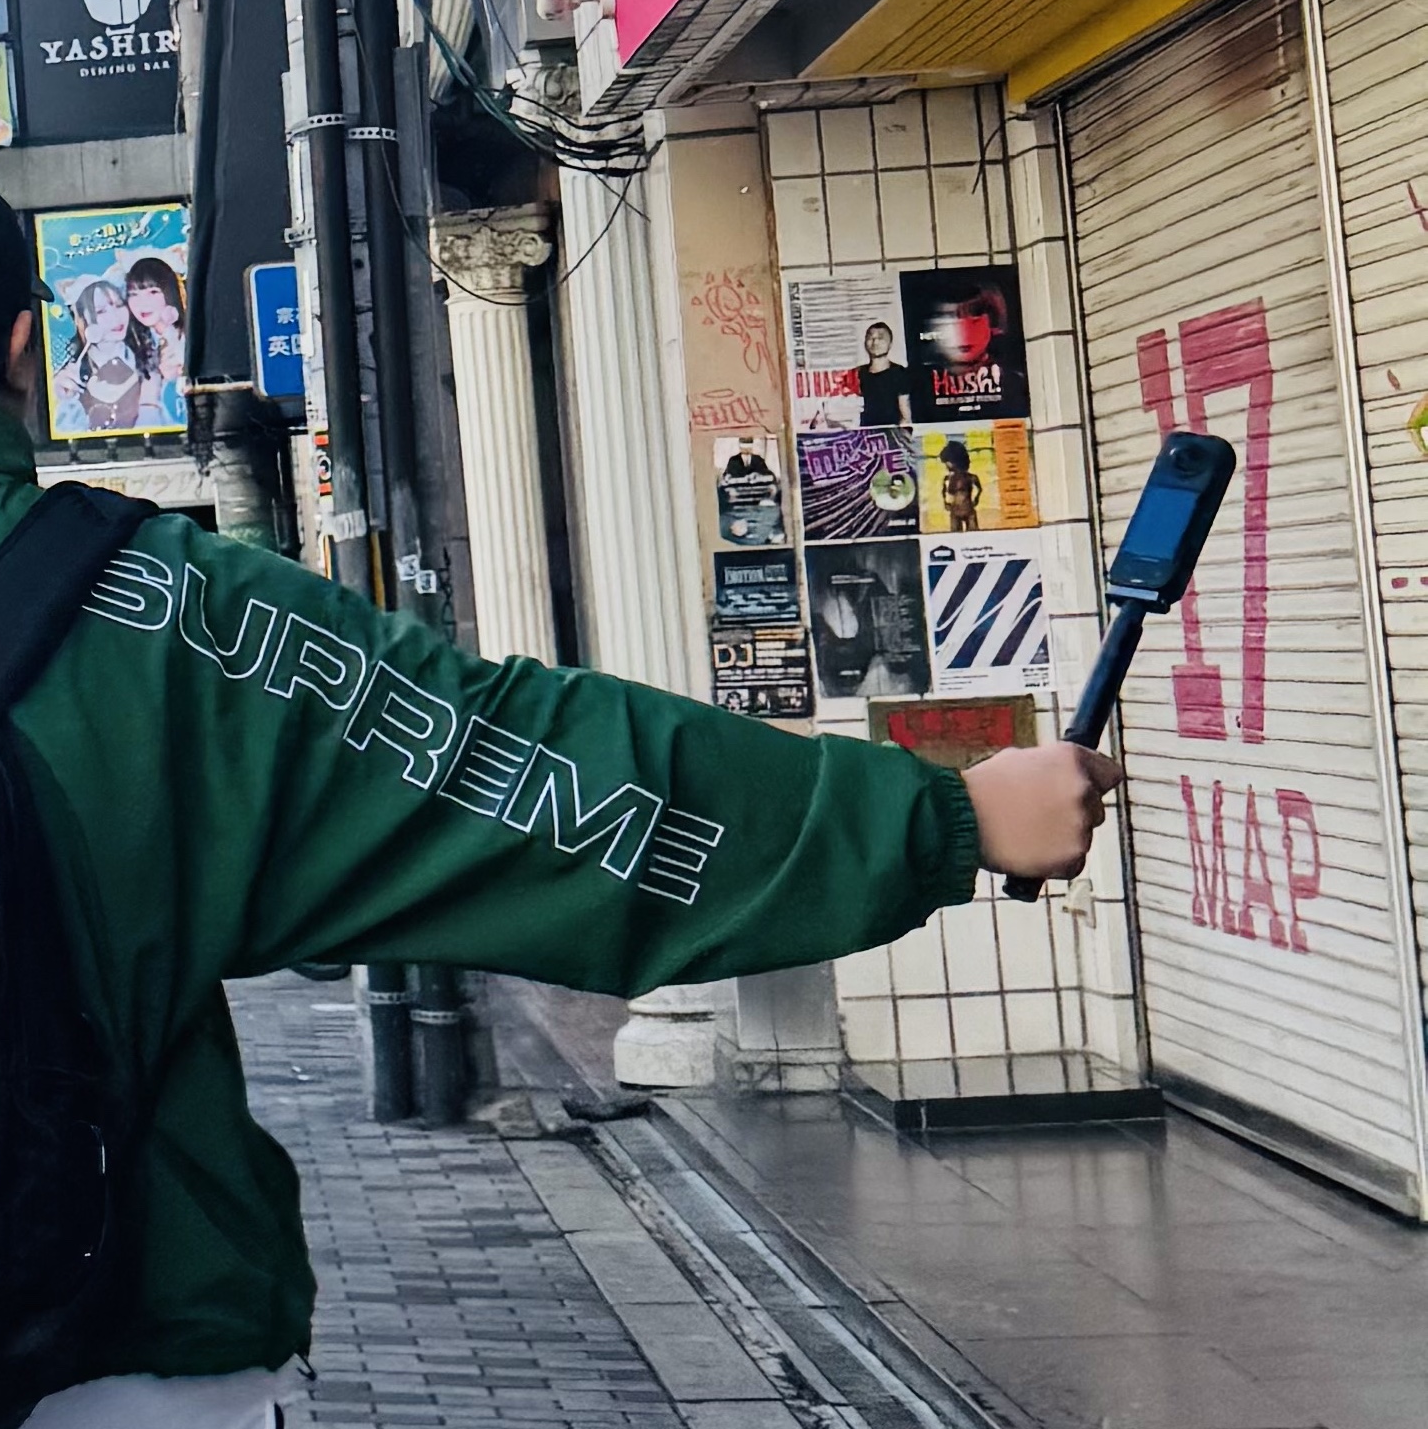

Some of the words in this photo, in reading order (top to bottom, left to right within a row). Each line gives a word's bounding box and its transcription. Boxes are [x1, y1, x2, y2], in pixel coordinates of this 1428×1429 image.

[931, 363, 1003, 397] Hush!
[713, 643, 754, 669] DJ
[82, 547, 725, 908] SUPREME
[1180, 774, 1321, 953] MAP
